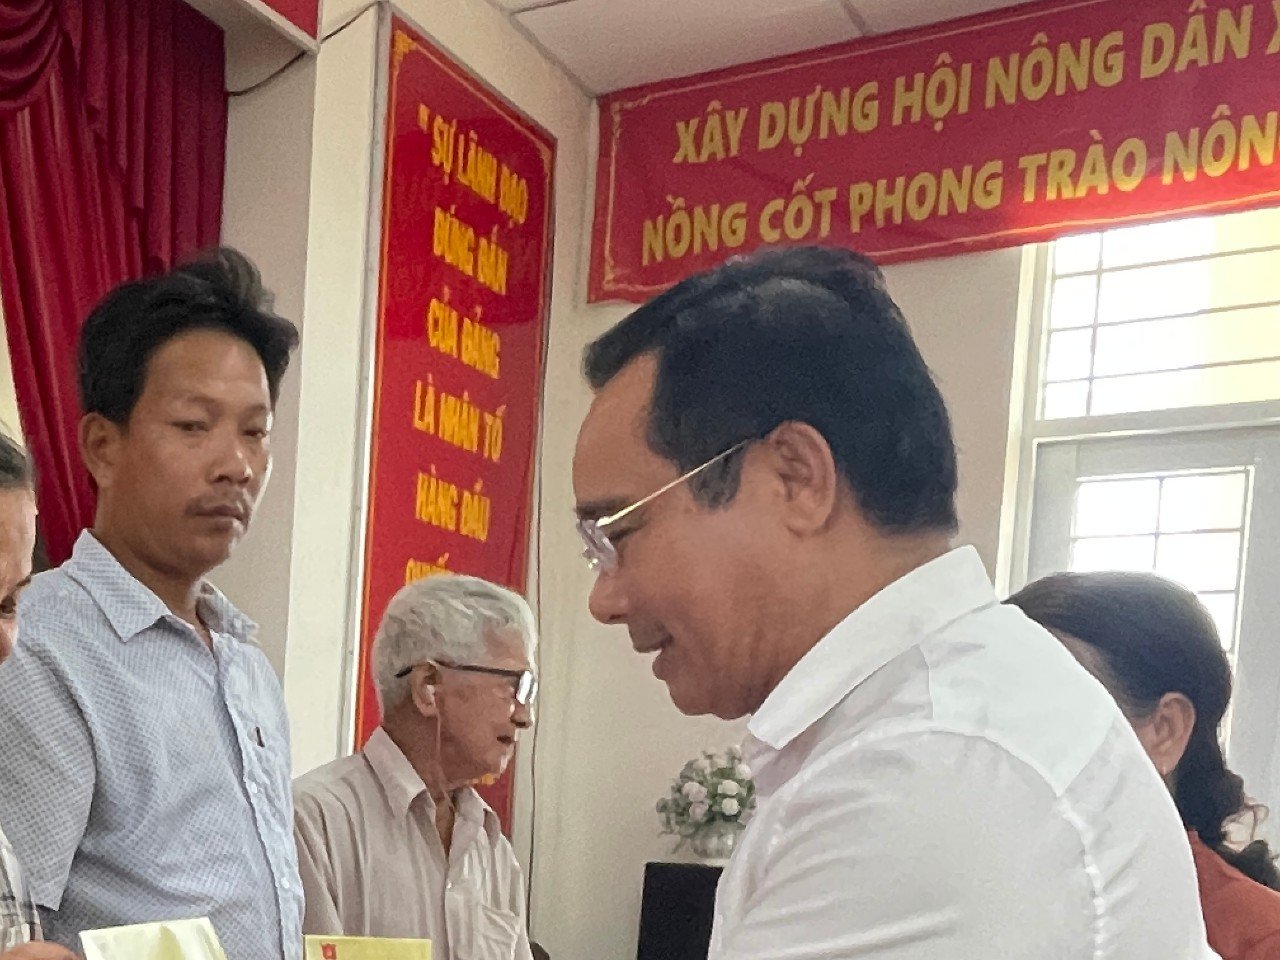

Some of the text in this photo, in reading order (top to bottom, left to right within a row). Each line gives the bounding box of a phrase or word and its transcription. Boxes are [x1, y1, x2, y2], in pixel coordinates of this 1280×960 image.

[673, 99, 749, 164] XÂY
[757, 82, 879, 158] DỰNG
[892, 52, 973, 133] HỘI
[985, 31, 1125, 110] NÔNG
[1140, 0, 1254, 79] DÂN
[641, 104, 1280, 267] NỒNG CỐT PHONG TRÀO NÔN
